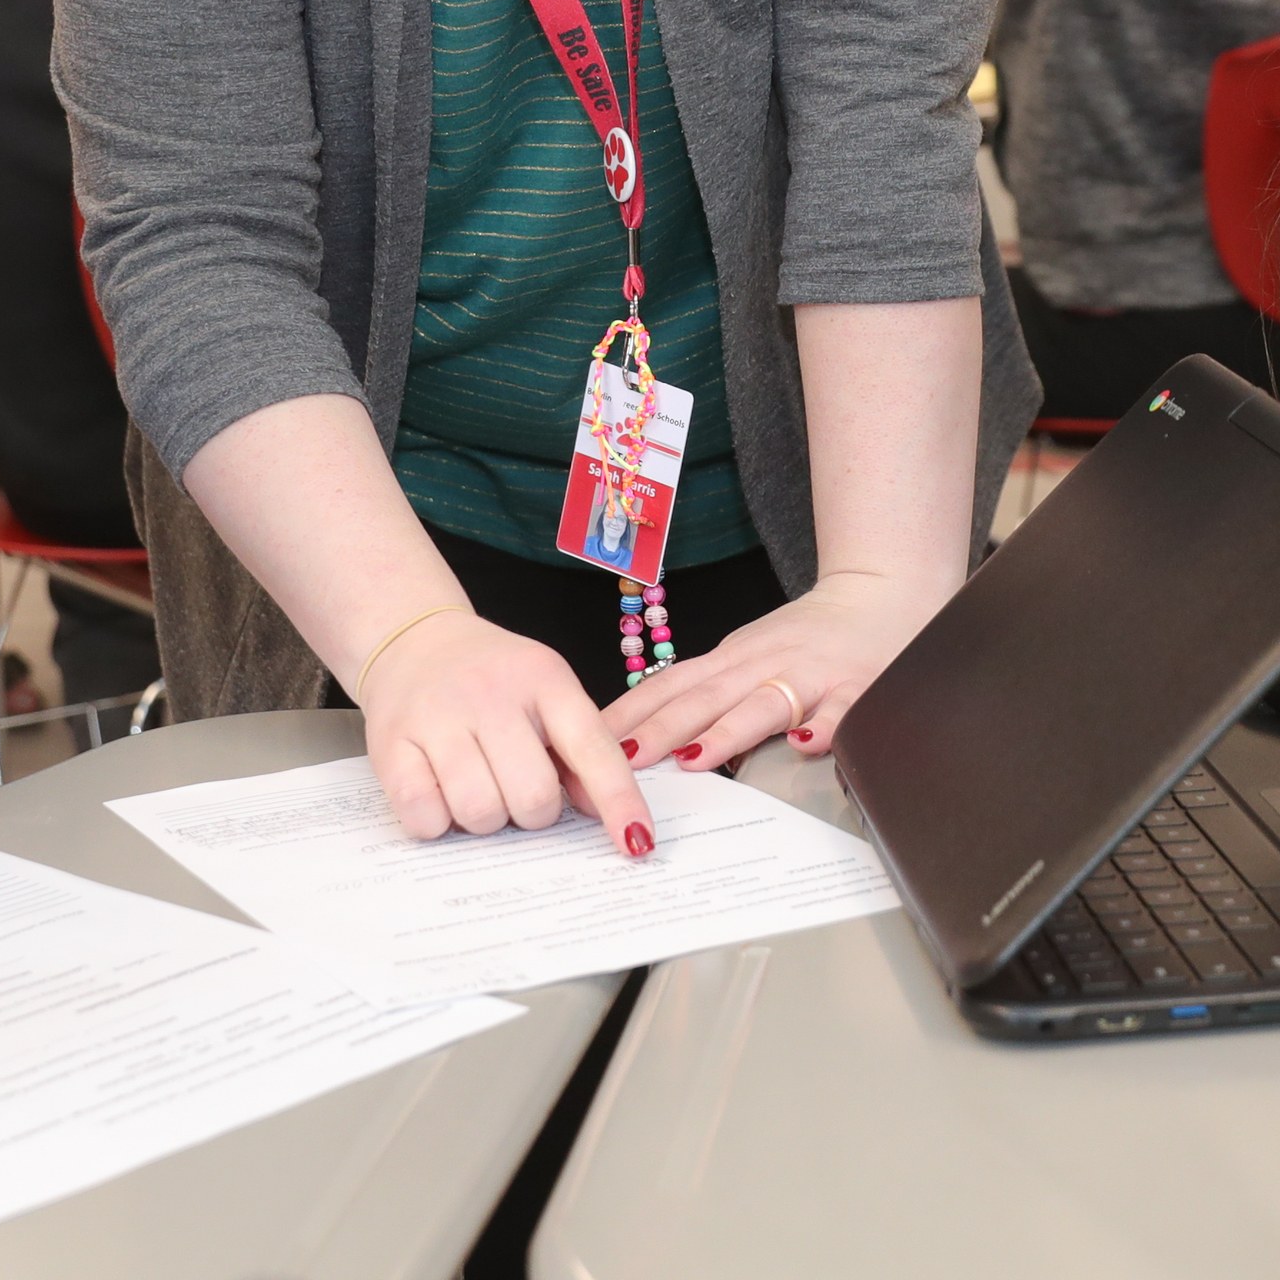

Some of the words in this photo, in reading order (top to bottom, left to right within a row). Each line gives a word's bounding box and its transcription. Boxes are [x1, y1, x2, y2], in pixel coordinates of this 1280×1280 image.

[558, 25, 587, 62] Be
[576, 61, 612, 113] Safe
[657, 412, 685, 429] Schools
